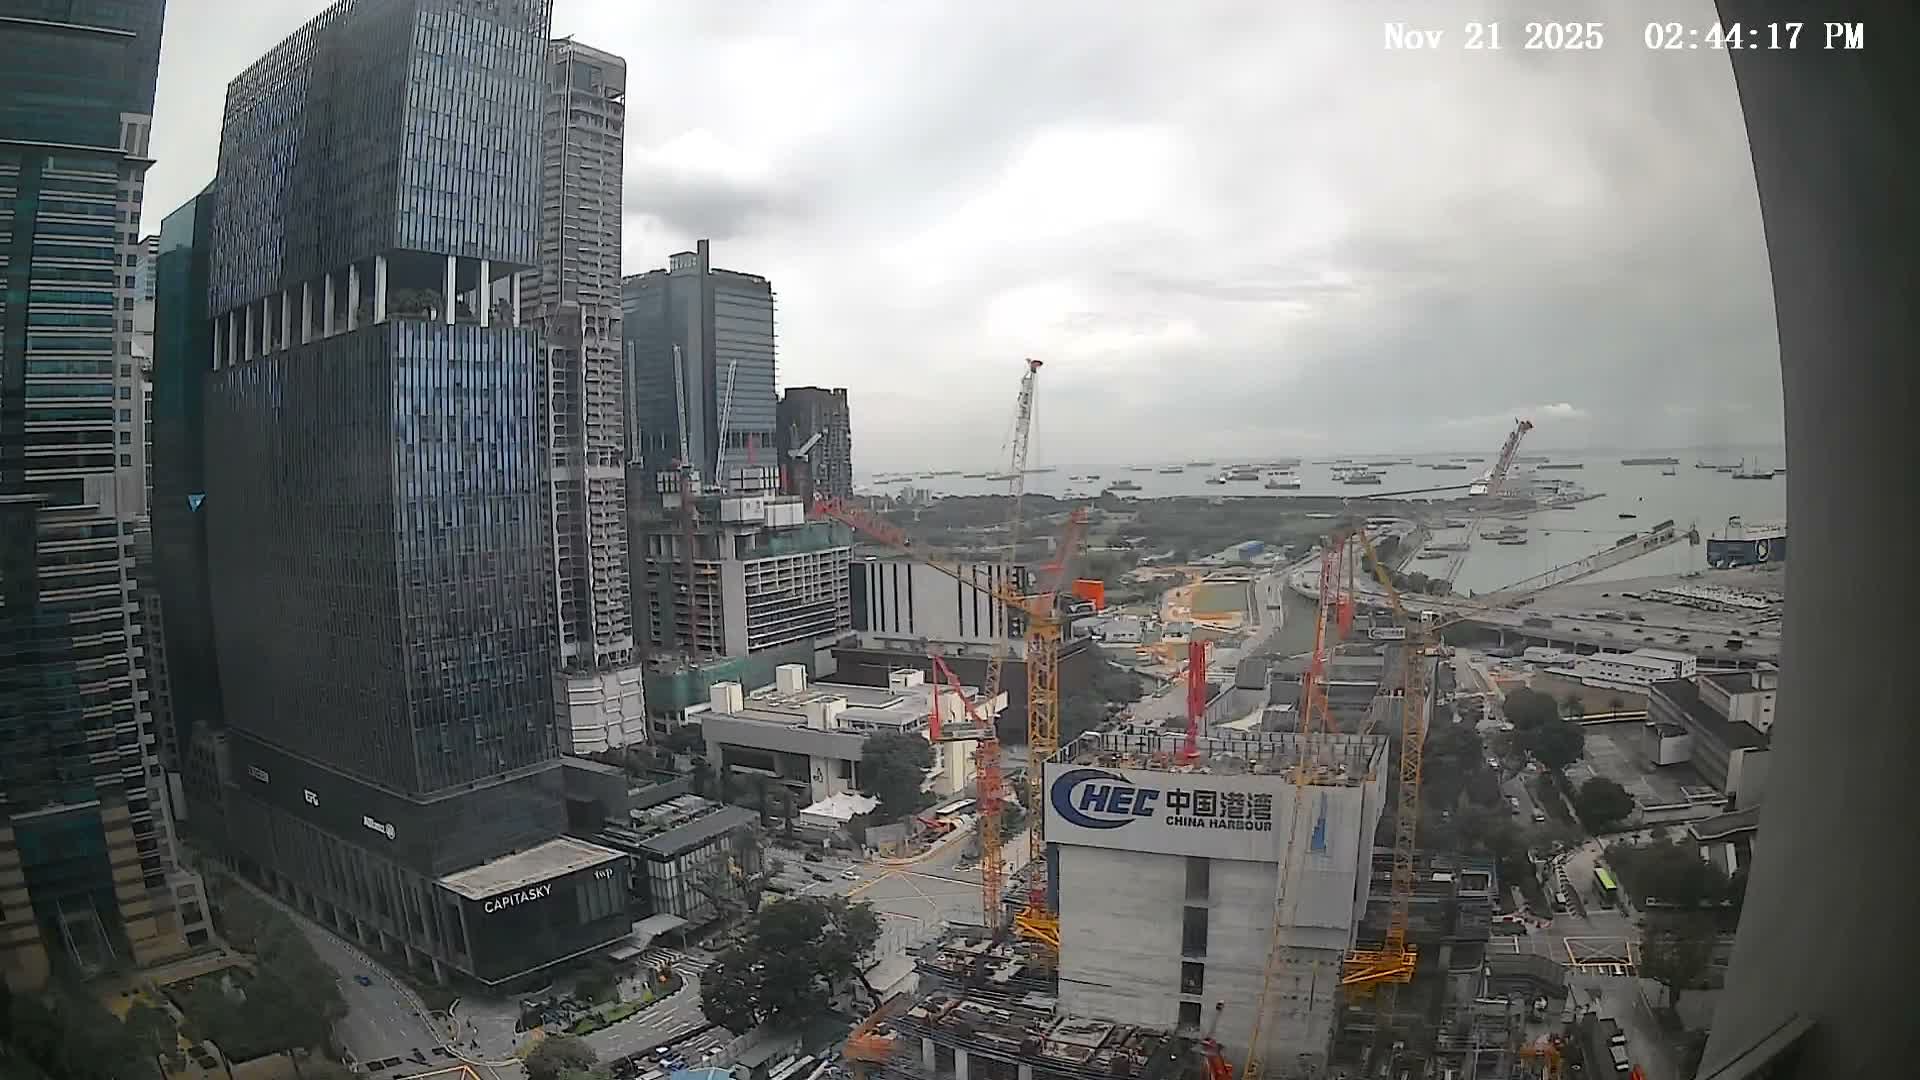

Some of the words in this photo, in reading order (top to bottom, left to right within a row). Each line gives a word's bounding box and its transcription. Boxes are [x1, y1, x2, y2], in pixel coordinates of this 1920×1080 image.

[1166, 788, 1273, 820] 中国港湾
[1165, 816, 1205, 828] CHINA
[1209, 819, 1273, 832] HARBOUR
[484, 883, 552, 913] CAPITASKY
